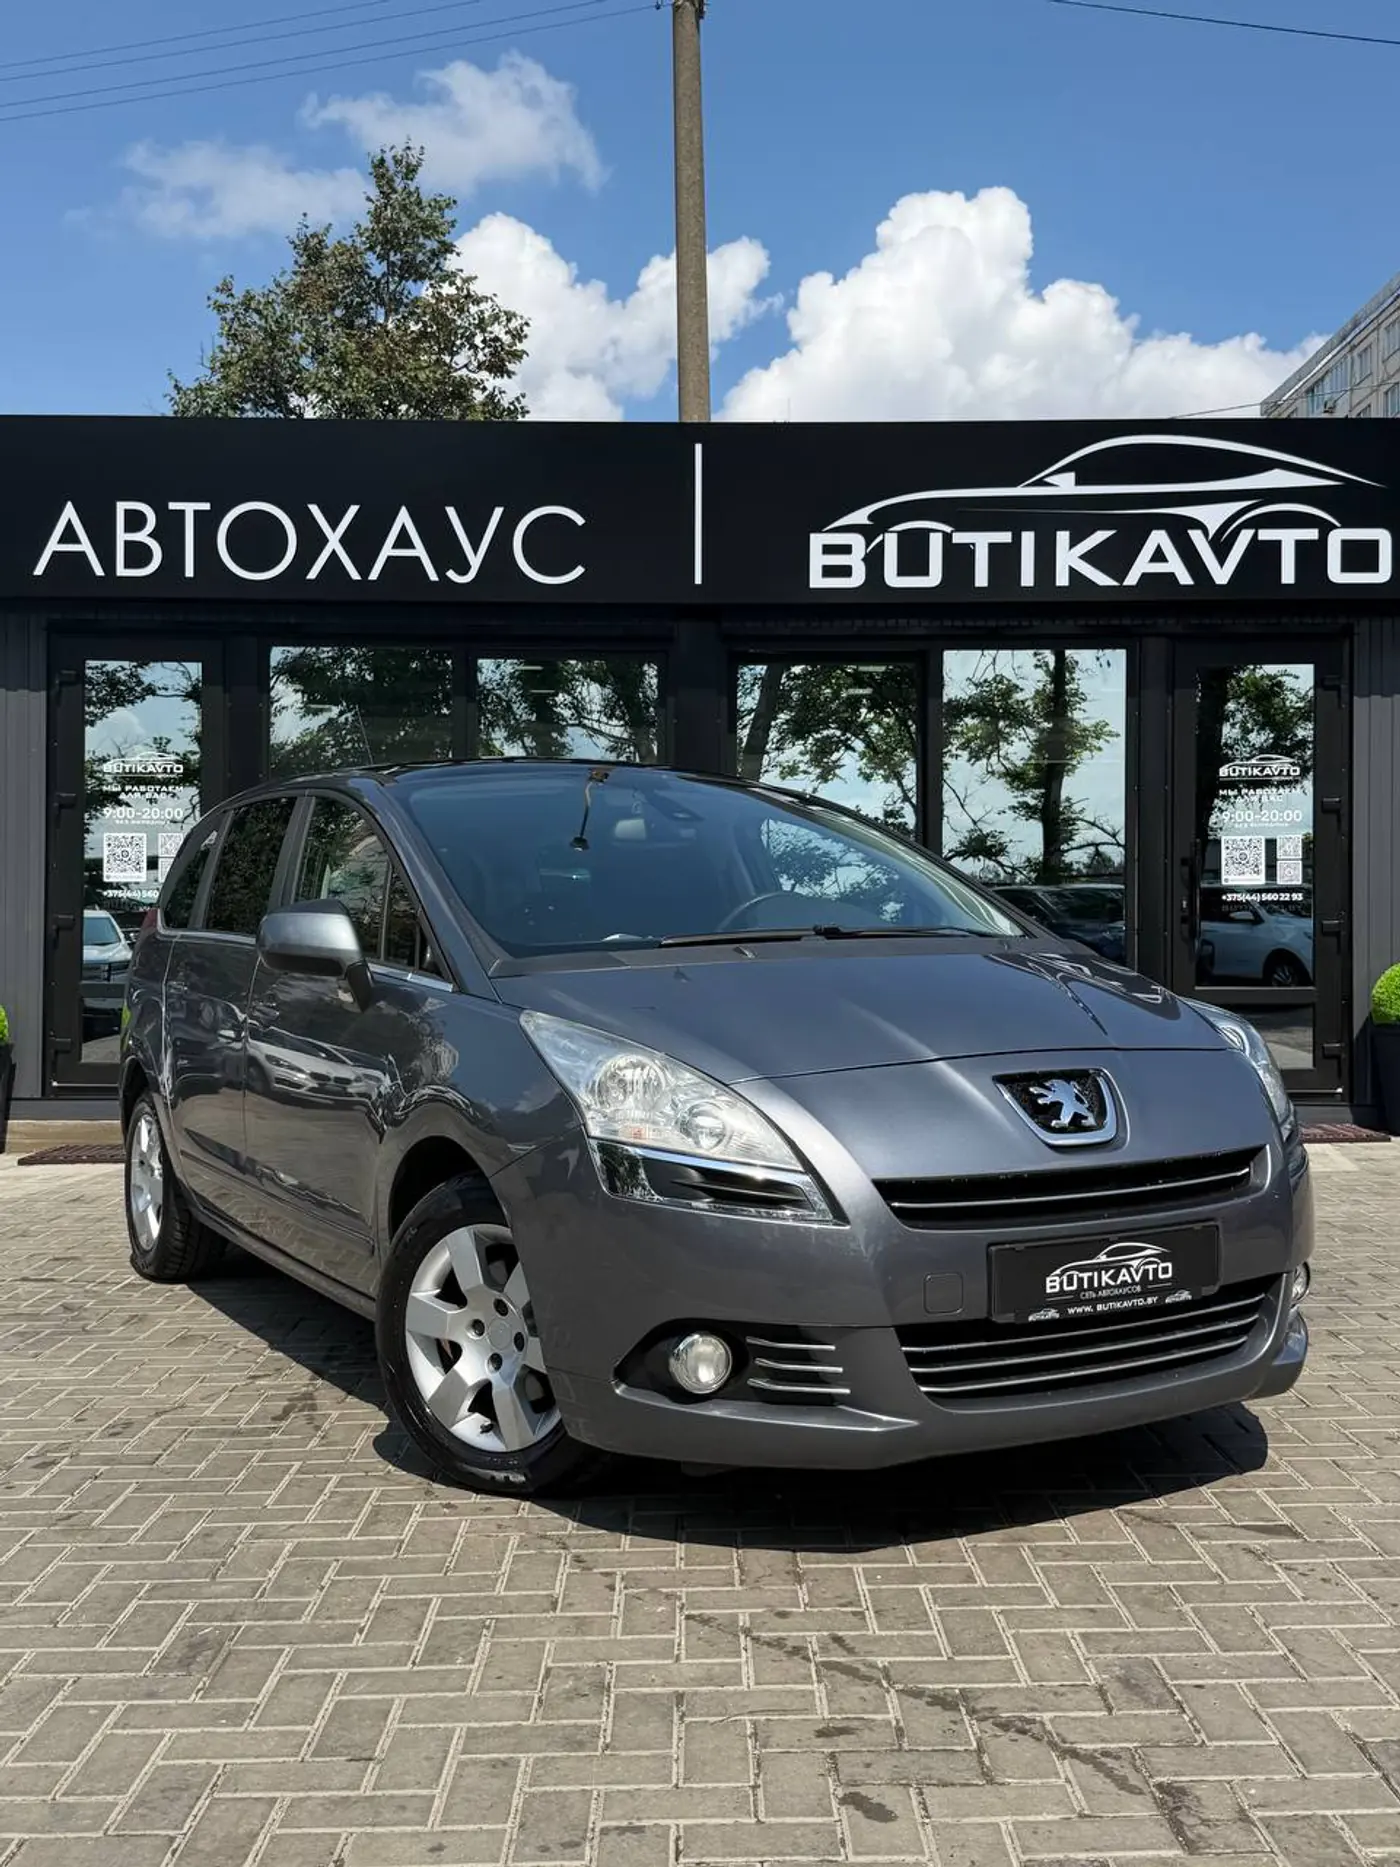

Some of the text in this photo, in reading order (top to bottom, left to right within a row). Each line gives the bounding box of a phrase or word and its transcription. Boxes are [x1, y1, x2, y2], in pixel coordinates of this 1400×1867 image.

[33, 500, 586, 585] АВТОХАУС
[808, 527, 1393, 588] BUTIKAVTO
[103, 764, 183, 773] BUTIKAVTO
[1219, 767, 1300, 776] BUTIKAVTO
[103, 807, 184, 819] 9:00-20:00
[1223, 810, 1302, 822] 9:00-20:00
[1261, 893, 1279, 901] 560
[1279, 893, 1290, 901] 22
[1045, 1261, 1173, 1294] BUTIKAVTO
[1067, 1305, 1094, 1315] WWW.
[1096, 1296, 1158, 1311] BUTIKAVTO.BY
